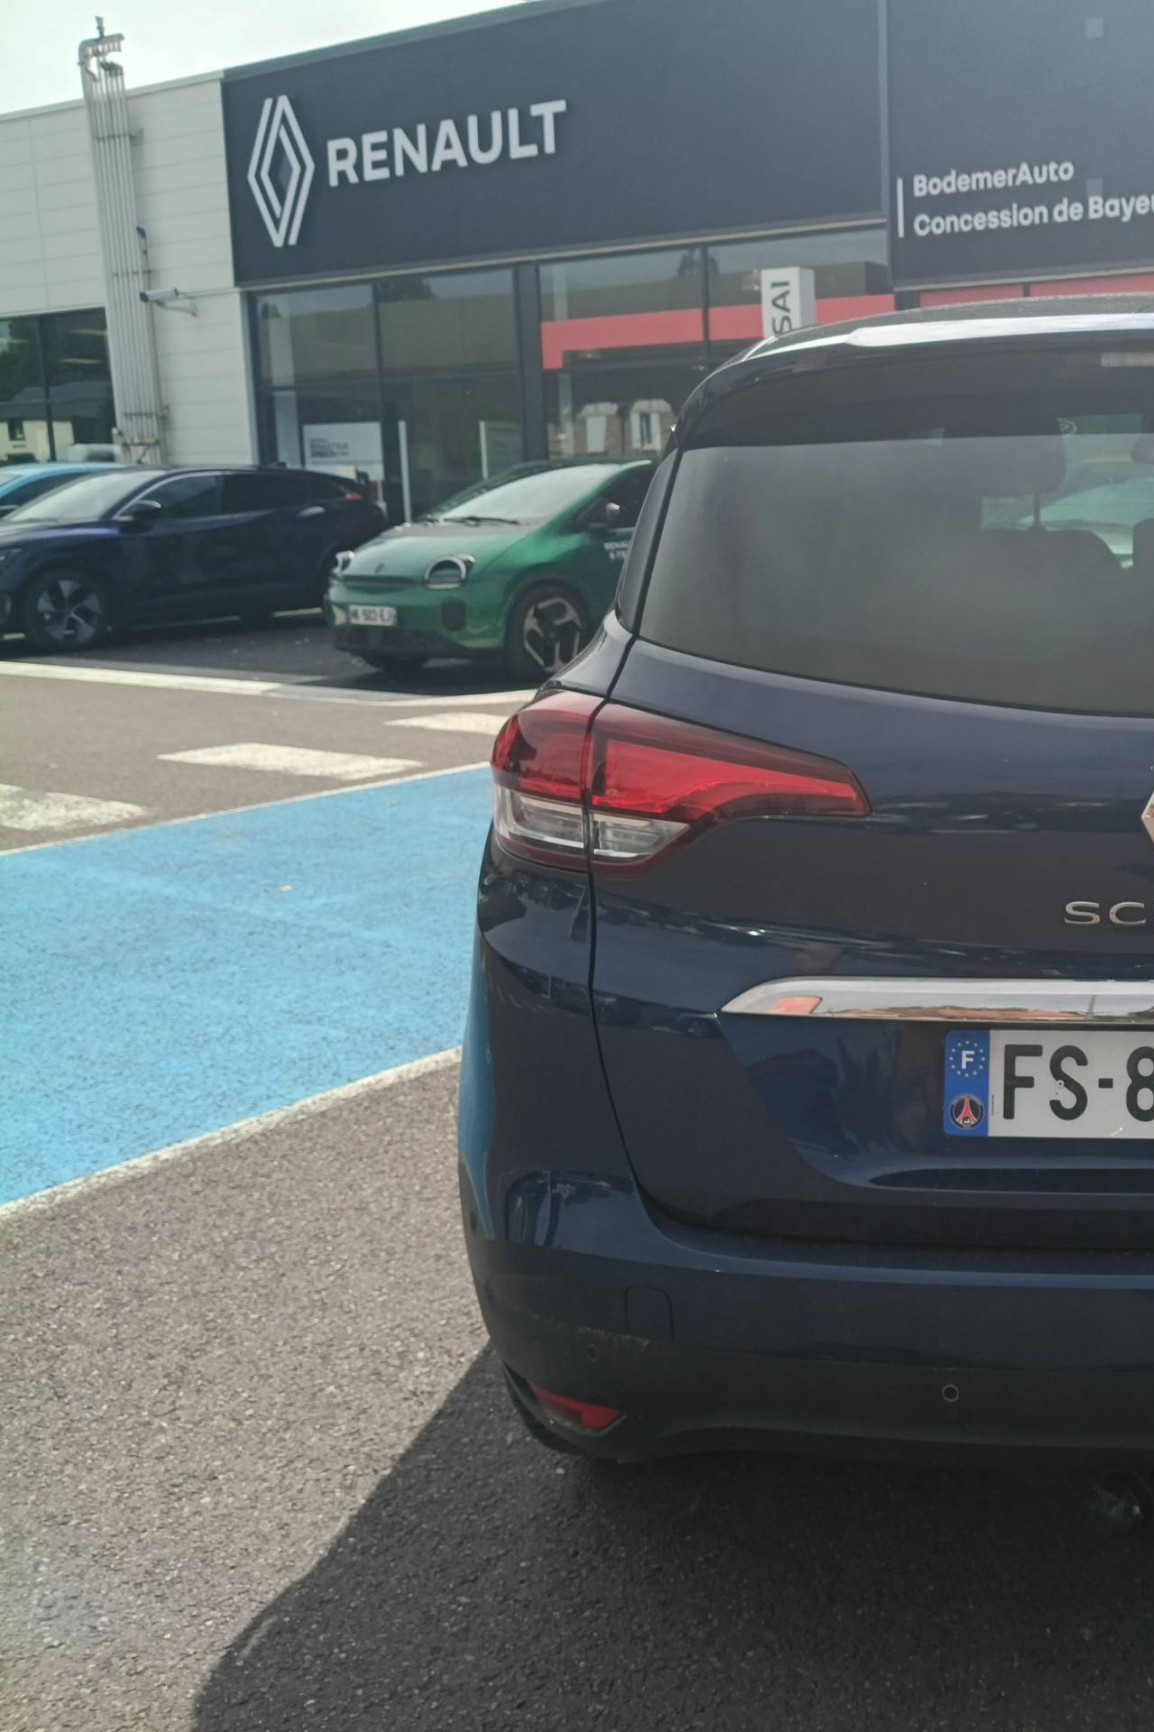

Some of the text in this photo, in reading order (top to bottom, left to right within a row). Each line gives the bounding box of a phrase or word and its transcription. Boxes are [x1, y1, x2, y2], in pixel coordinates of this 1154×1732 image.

[327, 99, 567, 188] RENAULT
[913, 160, 1075, 197] BodemerAuto
[913, 203, 1049, 237] Concession
[1053, 197, 1084, 224] de
[961, 1050, 976, 1070] F
